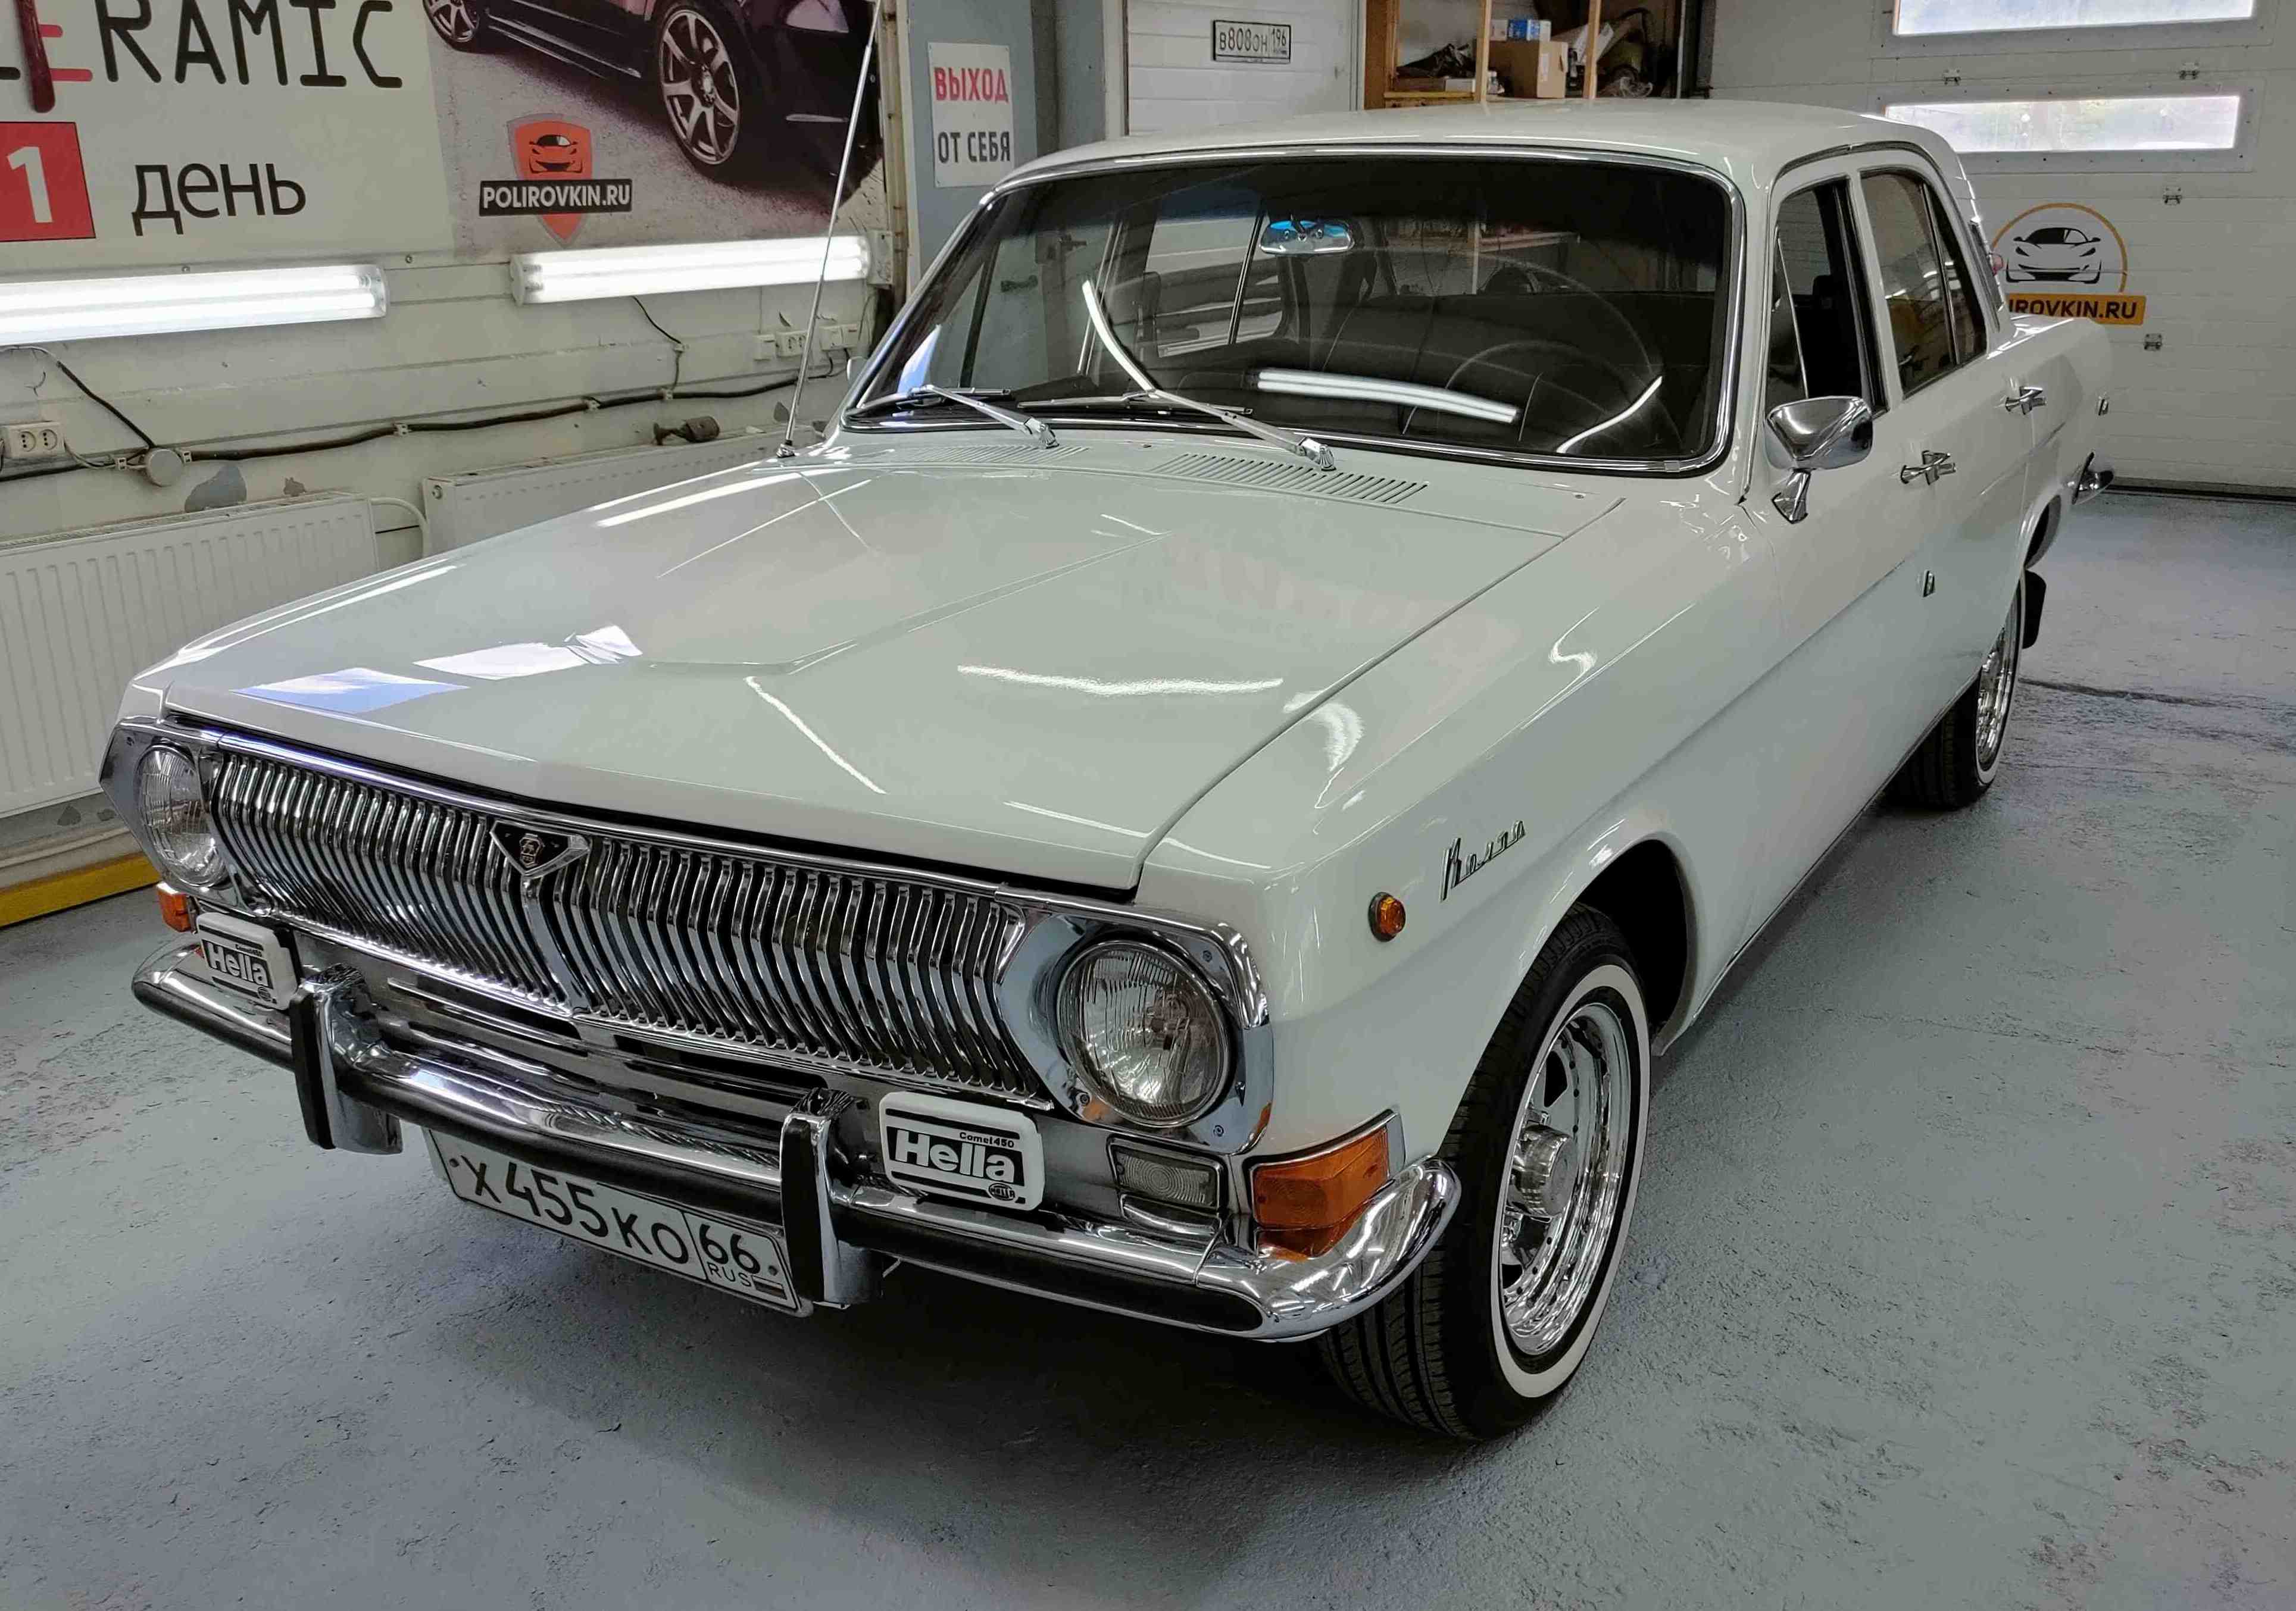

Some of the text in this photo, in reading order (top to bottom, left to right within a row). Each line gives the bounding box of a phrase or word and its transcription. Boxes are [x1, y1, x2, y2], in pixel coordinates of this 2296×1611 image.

[0, 0, 402, 88] ERAMIC
[1272, 27, 1287, 52] 196
[934, 66, 1009, 104] ВЫХОД
[938, 130, 1011, 164] ОТ СЕБЯ
[7, 146, 307, 236] 1 день
[483, 184, 630, 208] POLIROVKIN.RU
[2009, 299, 2137, 319] IROVKIN.RU
[208, 941, 269, 988] Hella
[895, 1129, 1015, 1183] Hella
[699, 1223, 761, 1275] 66
[707, 1261, 752, 1287] RUS
